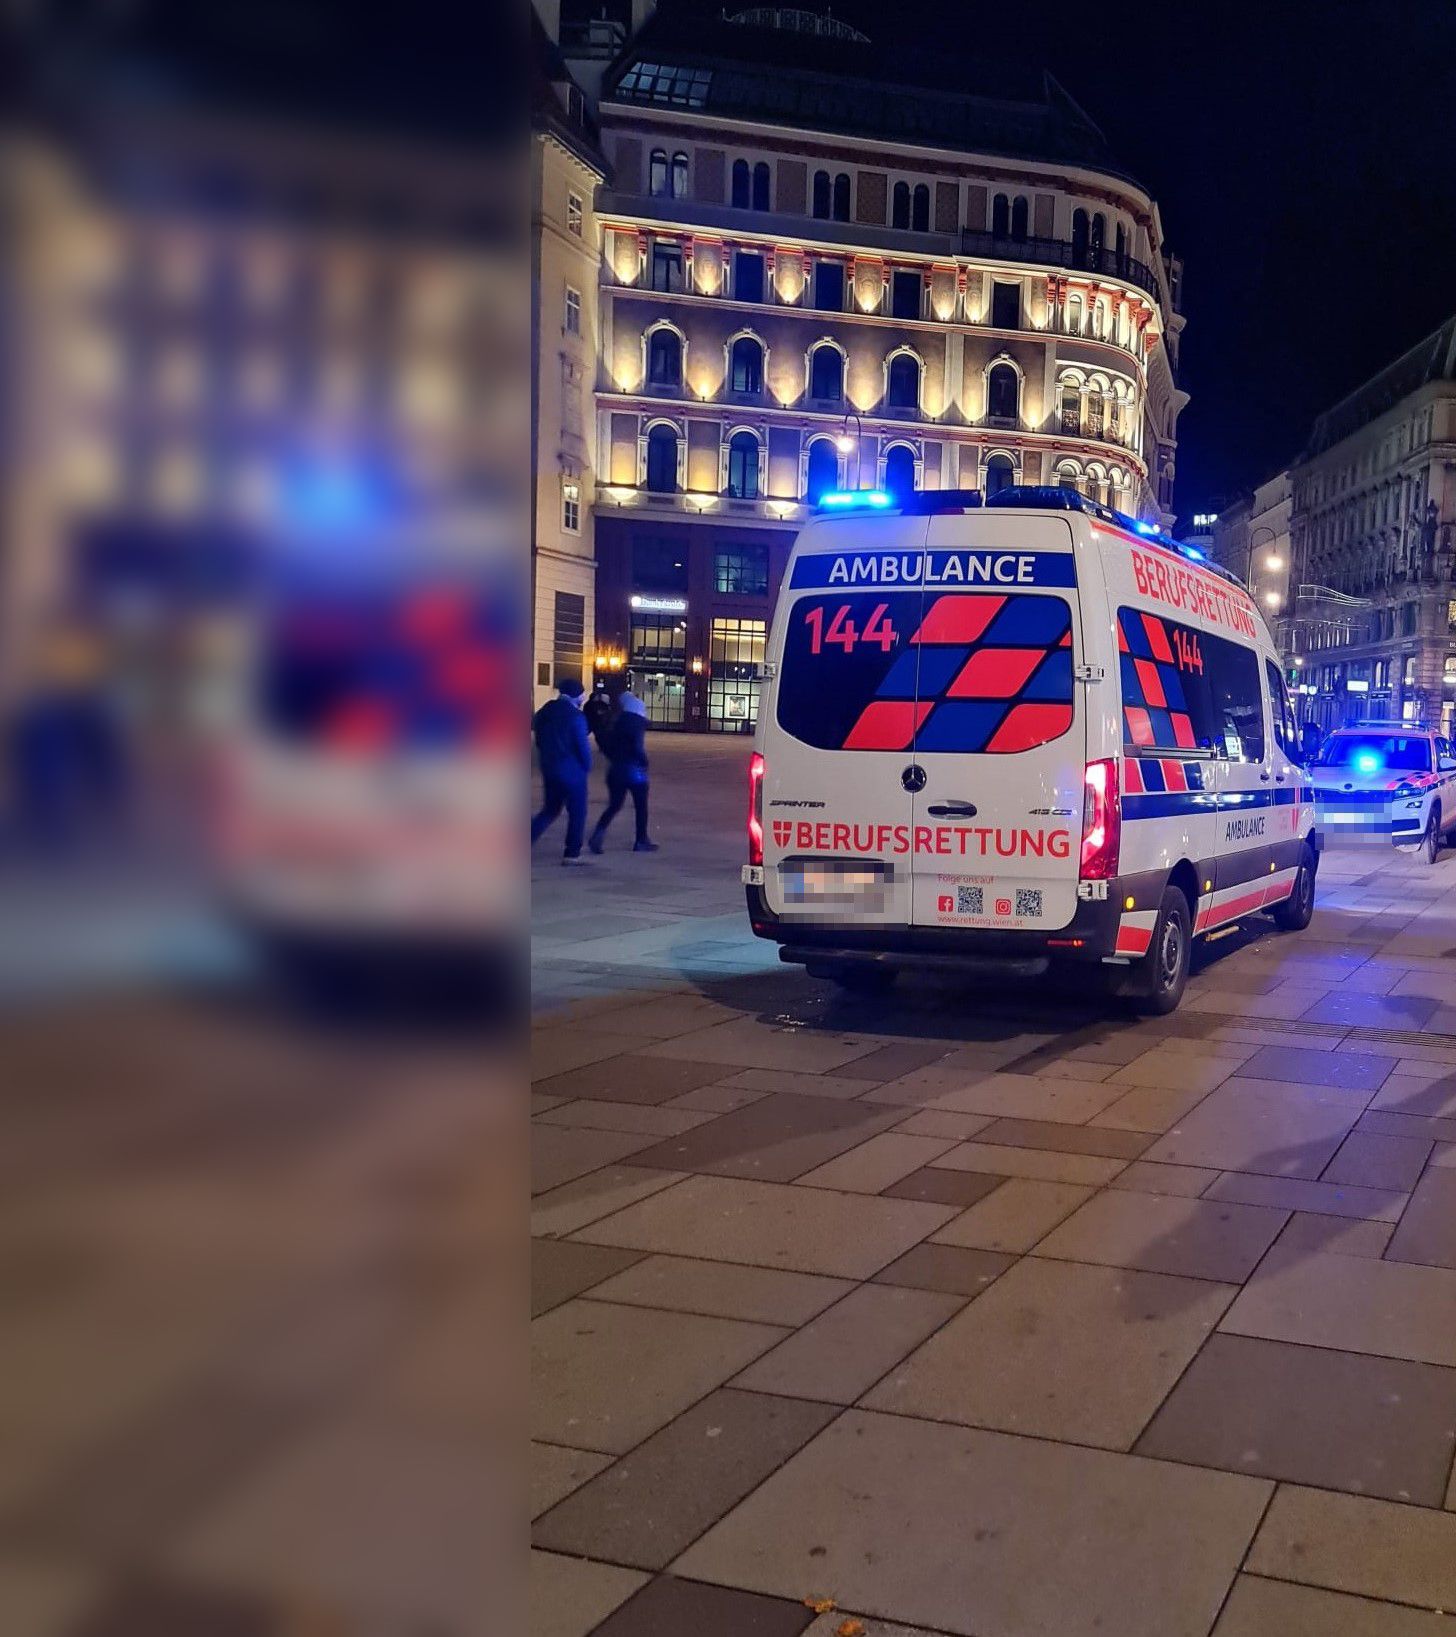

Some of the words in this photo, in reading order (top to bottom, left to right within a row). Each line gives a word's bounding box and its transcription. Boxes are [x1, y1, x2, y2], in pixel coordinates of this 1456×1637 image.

[828, 554, 1036, 583] AMBULANCE
[1130, 549, 1257, 639] BERUFSRETTUNG
[804, 603, 898, 655] 144
[1173, 629, 1204, 677] 144
[769, 800, 826, 808] SPRINTER
[796, 821, 1070, 858] BERUFSRETTUNG
[1225, 816, 1266, 841] AMBULANCE
